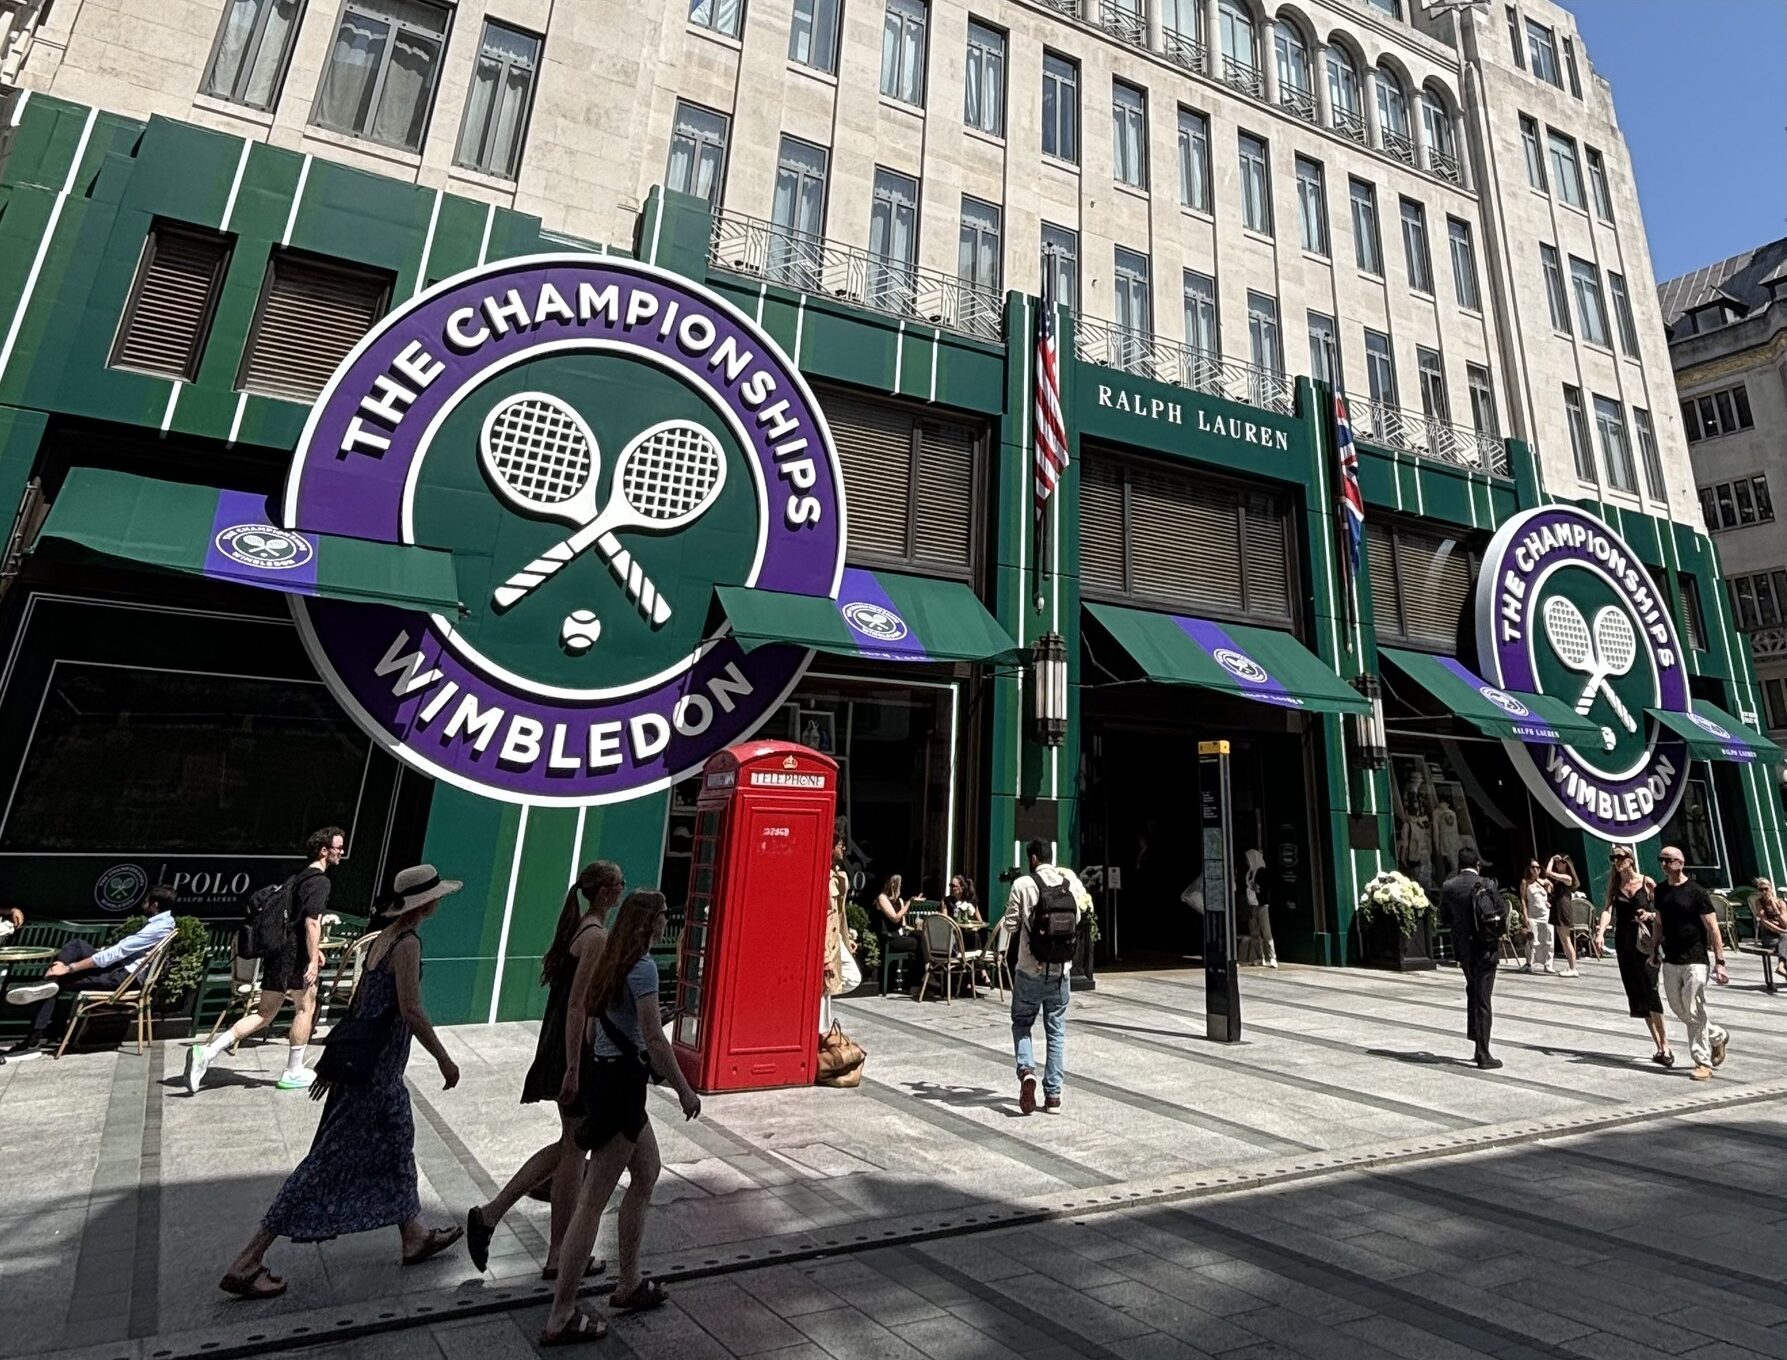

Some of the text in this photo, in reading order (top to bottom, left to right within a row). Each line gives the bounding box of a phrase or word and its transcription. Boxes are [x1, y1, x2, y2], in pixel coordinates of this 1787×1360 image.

[341, 283, 822, 526] THE CHAMPIONSHIPS
[1098, 384, 1289, 451] RALPH LAUREN
[1502, 522, 1675, 668] THE CHAMPIONSHIPS
[373, 630, 754, 768] WIMBLEDON
[754, 773, 823, 787] TELEPHONE
[1546, 743, 1676, 821] WIMBLEDON
[173, 872, 250, 895] POLO
